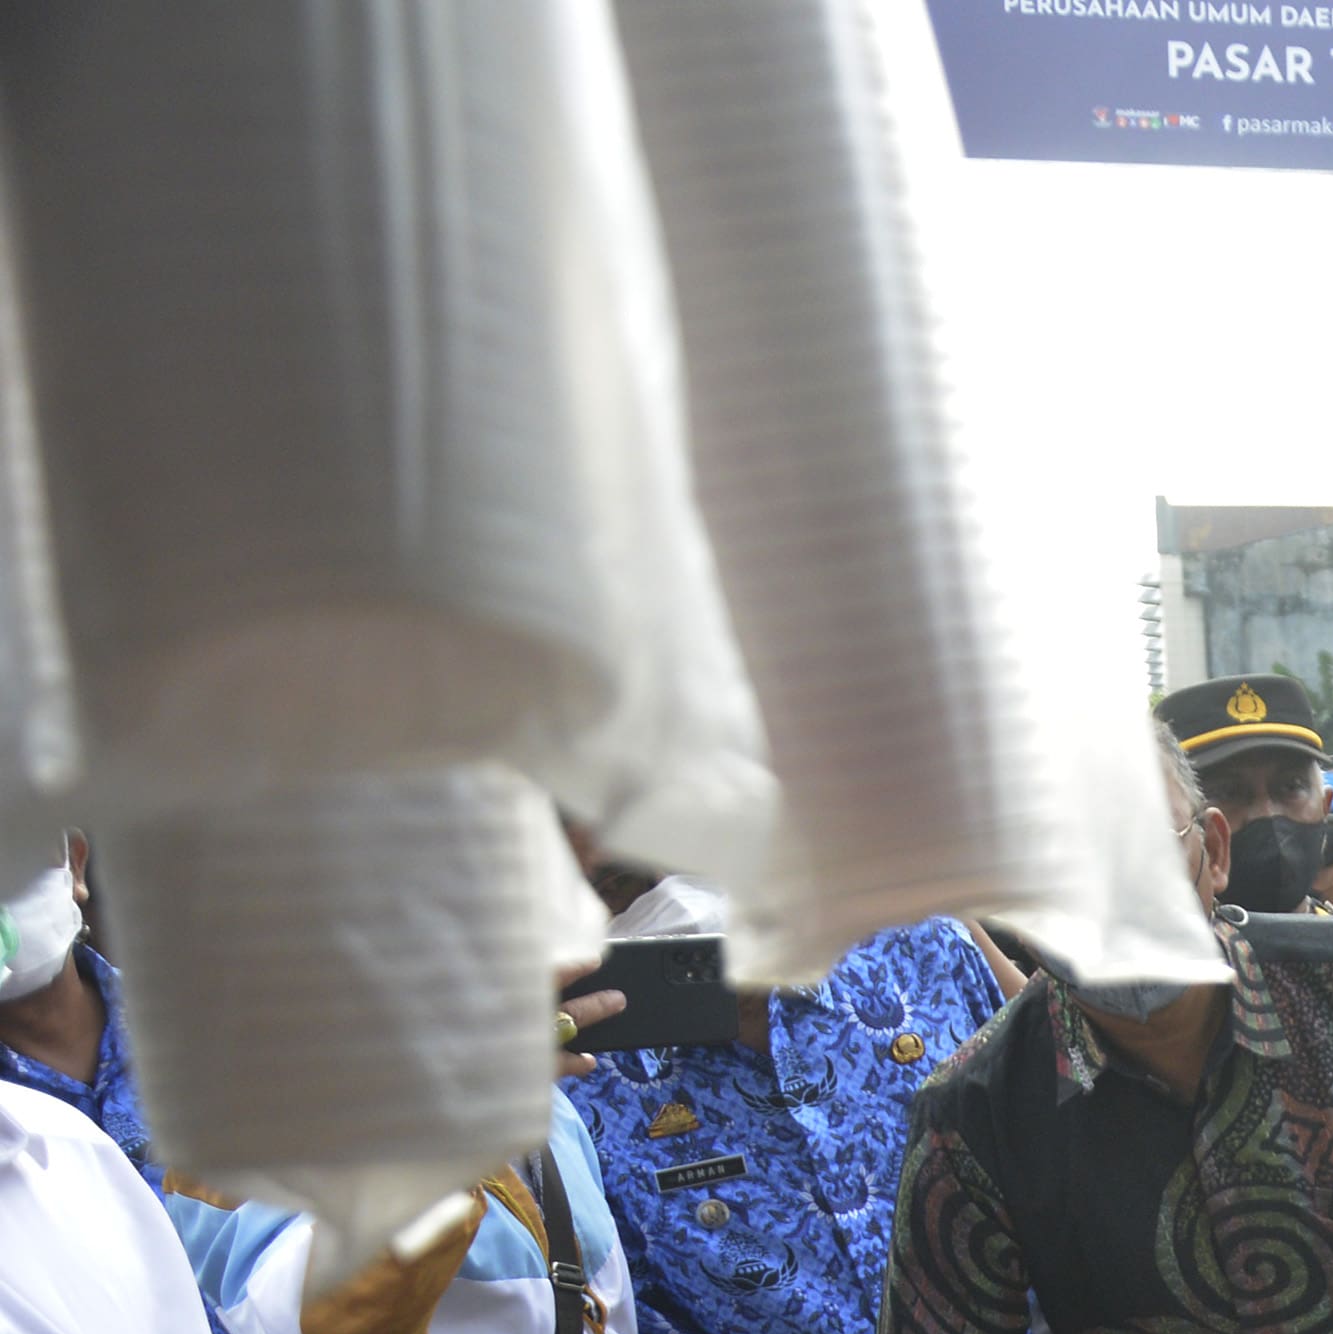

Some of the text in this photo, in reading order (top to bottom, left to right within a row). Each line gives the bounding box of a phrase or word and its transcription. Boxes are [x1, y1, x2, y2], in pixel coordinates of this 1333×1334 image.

[1003, 0, 1180, 21] PERUSAHAAN
[1188, 4, 1272, 26] UMUM
[1167, 39, 1315, 85] PASAR
[677, 1164, 726, 1183] ARMAN
